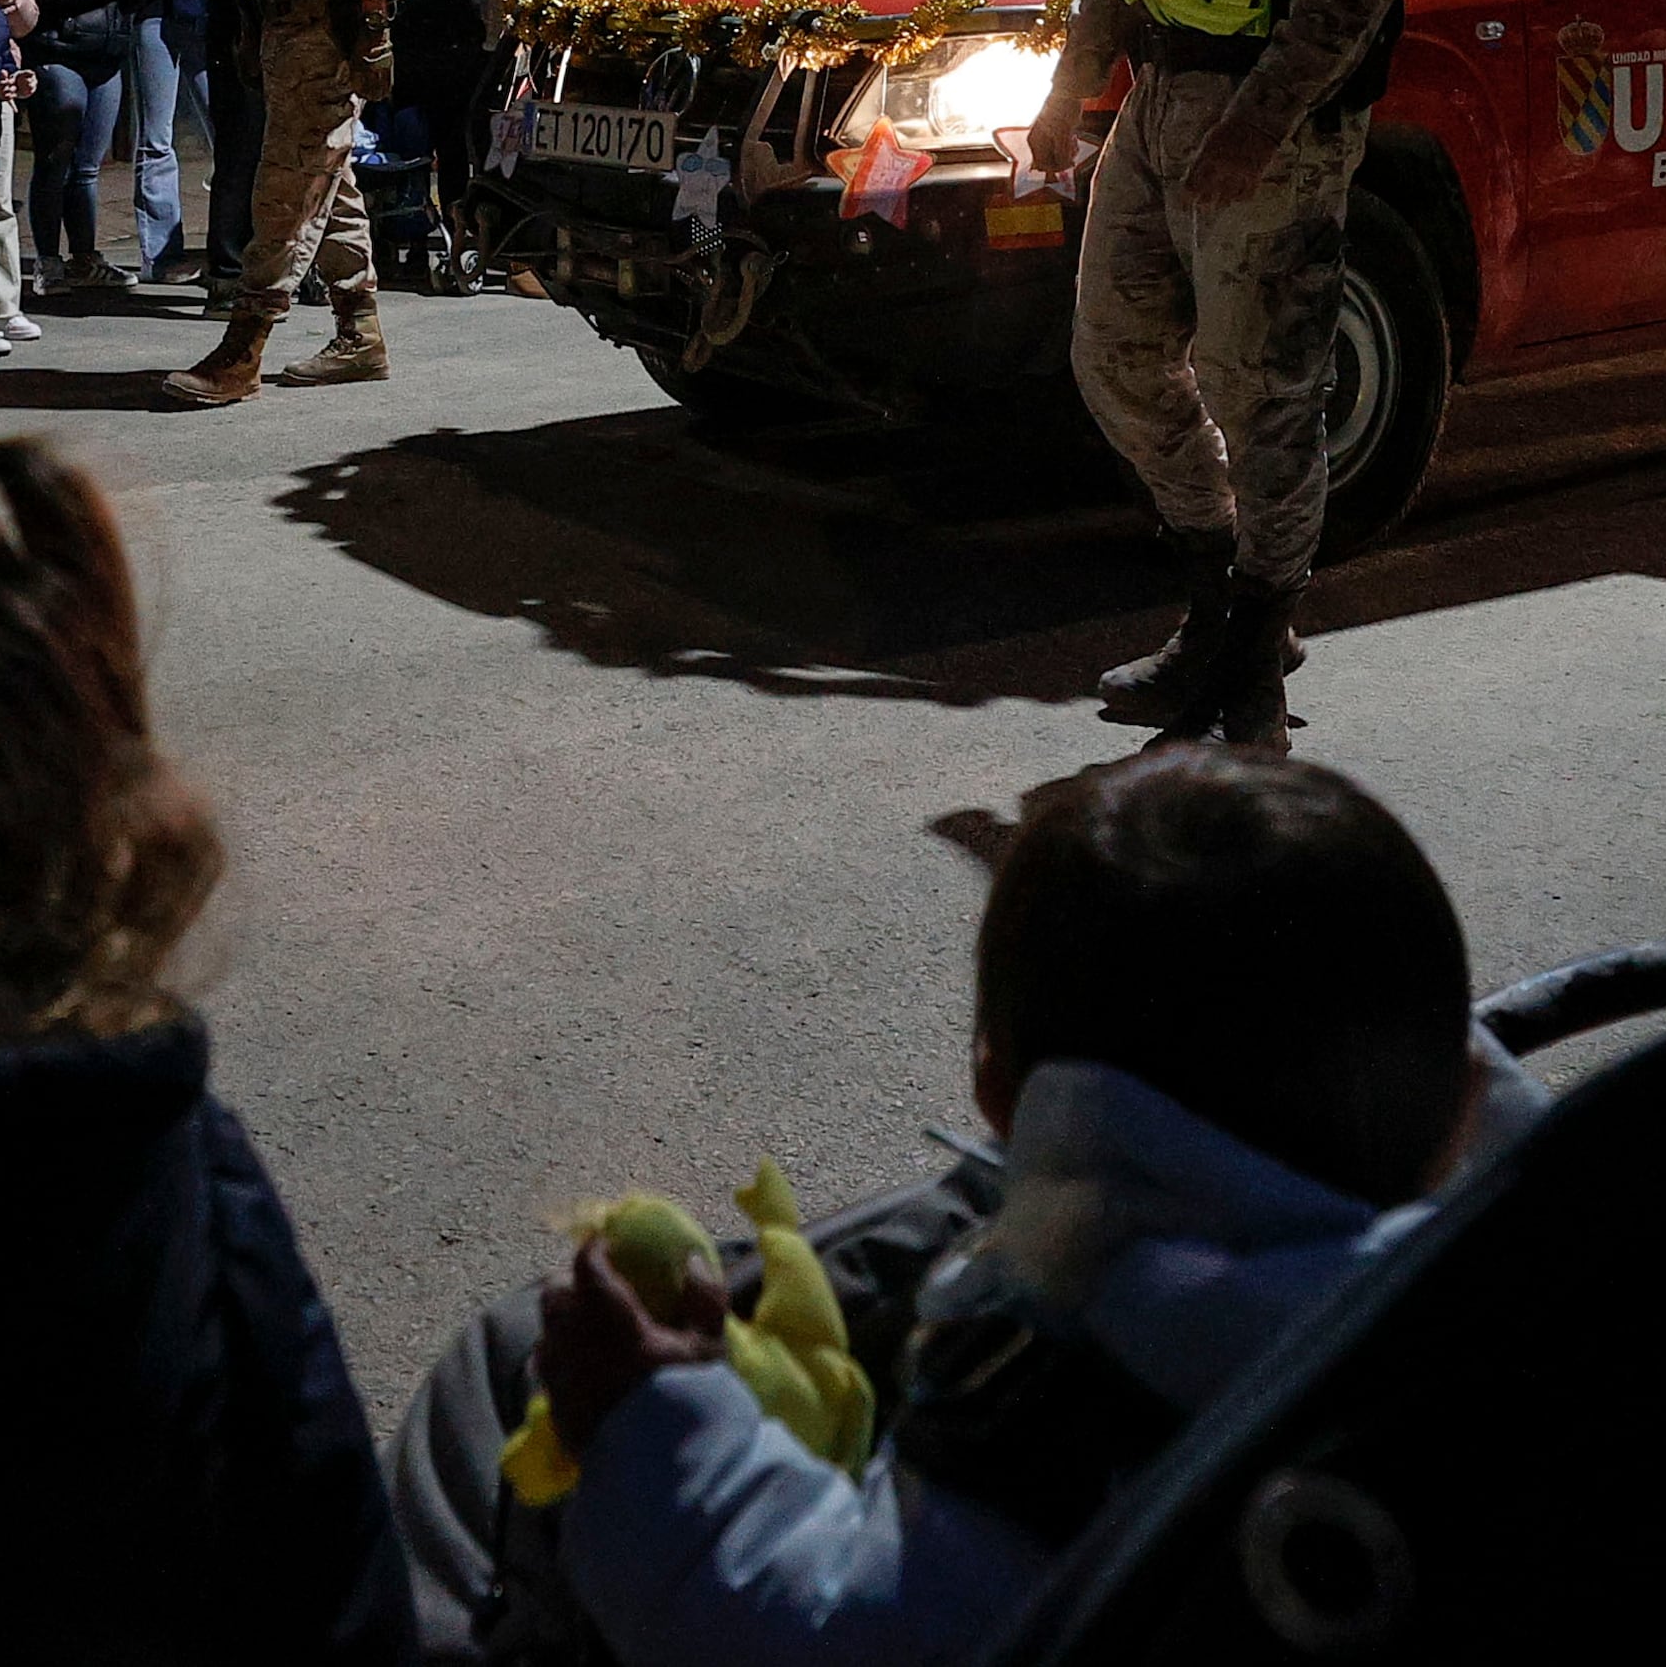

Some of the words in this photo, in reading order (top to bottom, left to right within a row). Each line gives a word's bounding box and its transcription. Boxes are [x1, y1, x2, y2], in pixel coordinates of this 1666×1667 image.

[1612, 51, 1651, 65] UNIDAD
[536, 109, 563, 150] ET
[571, 112, 664, 163] 120170
